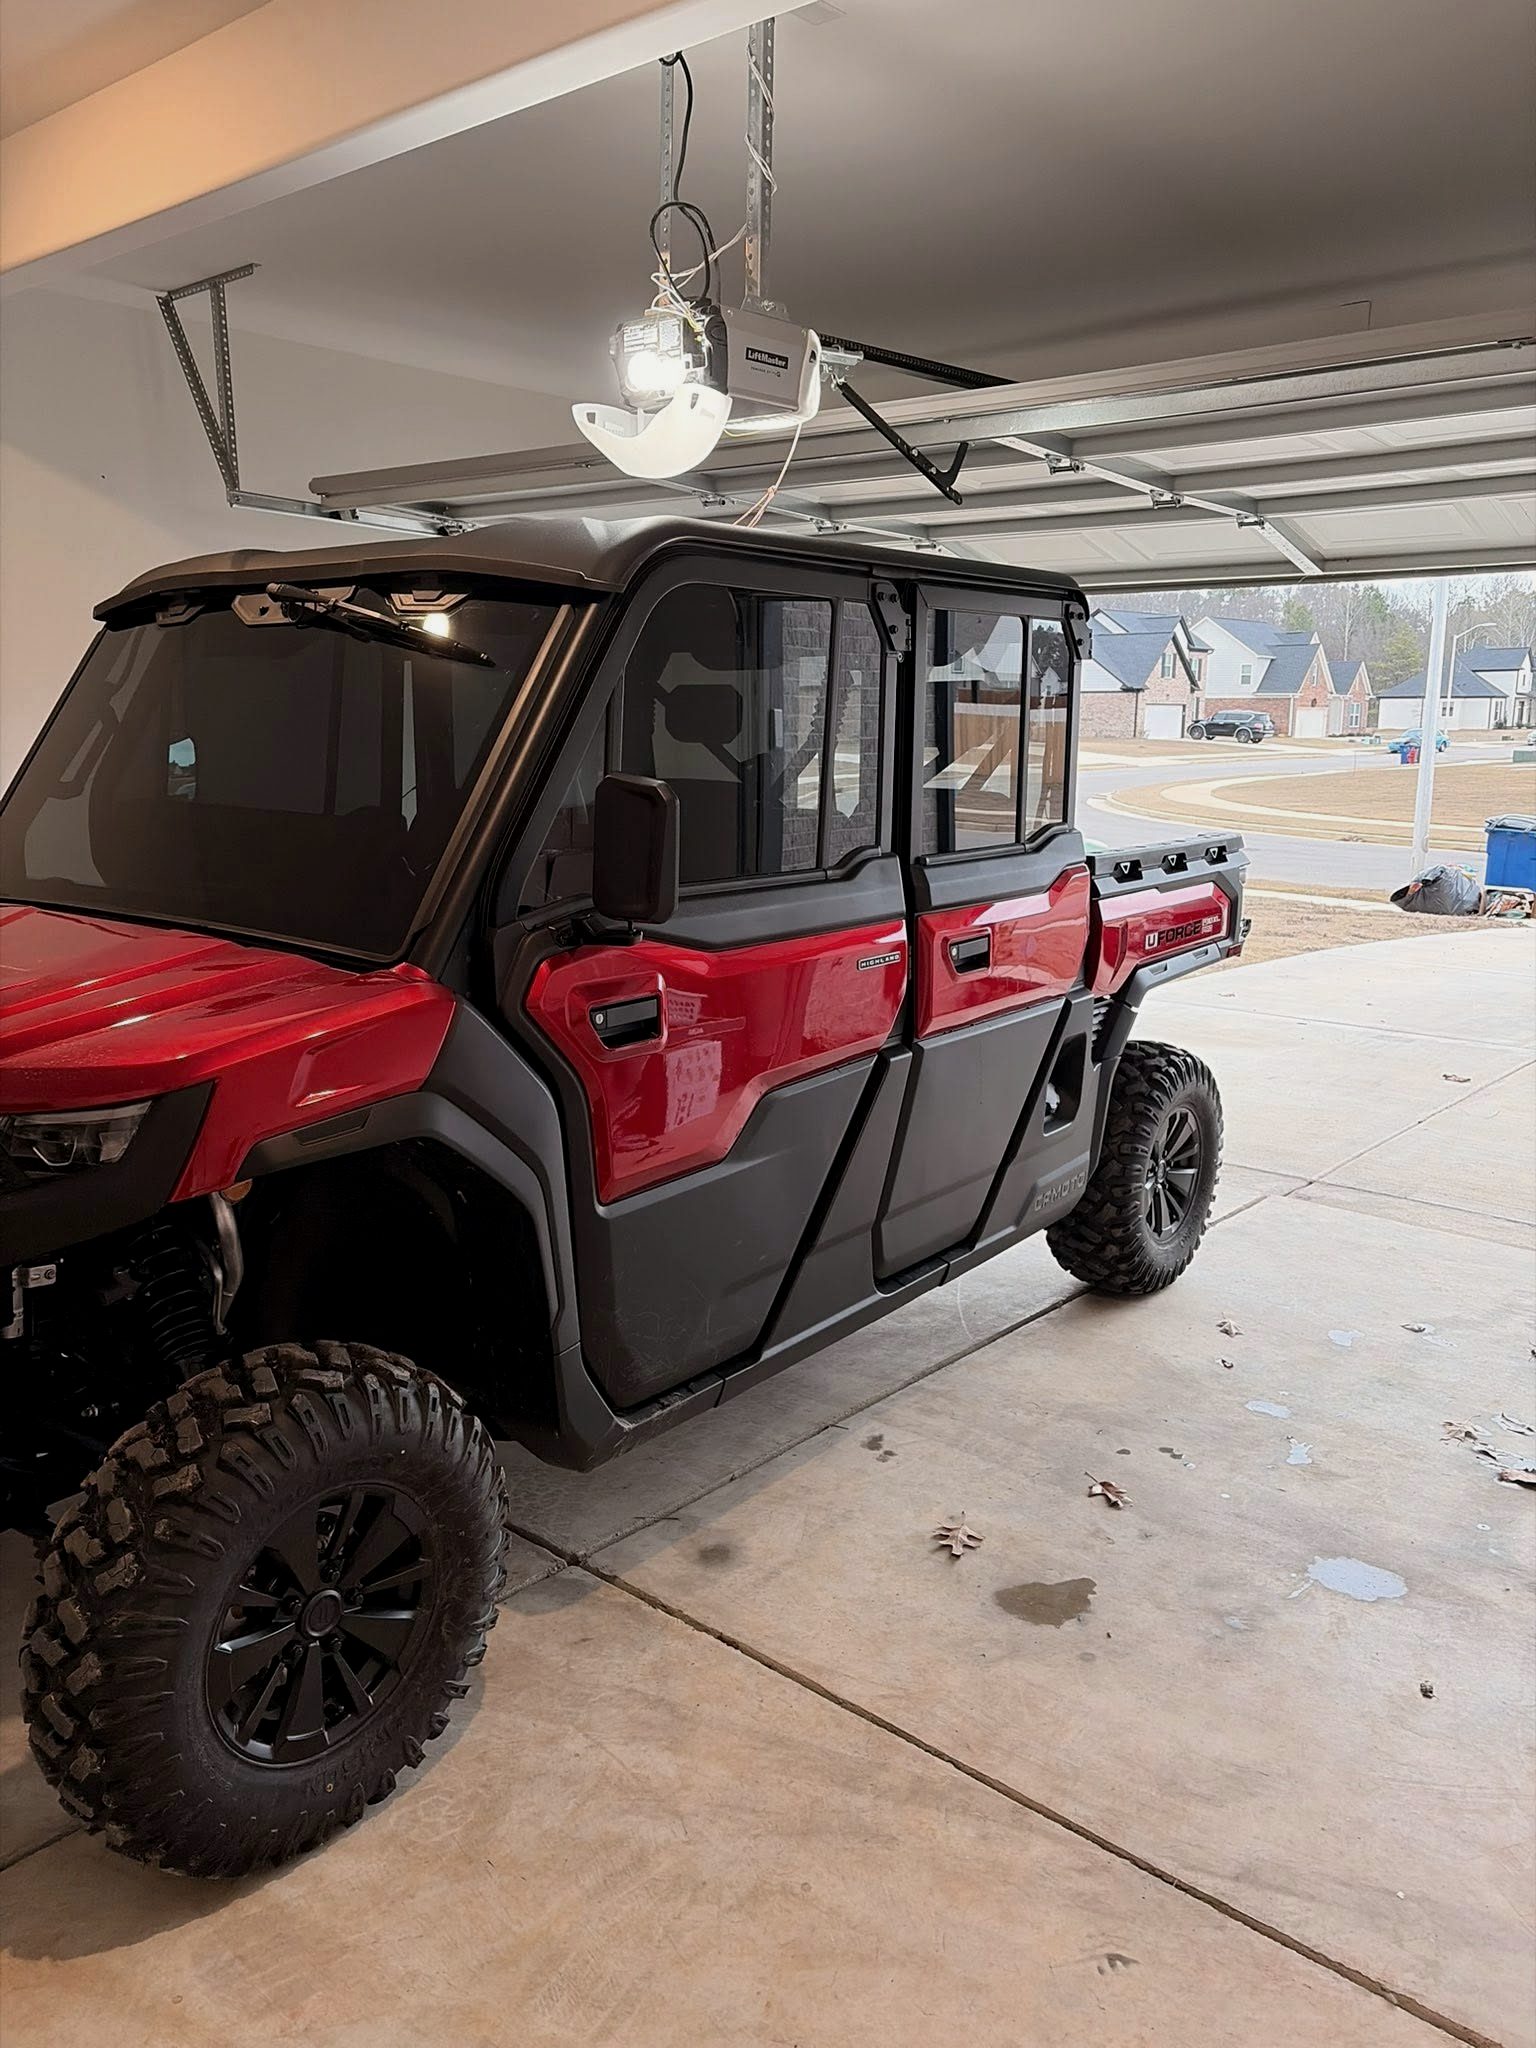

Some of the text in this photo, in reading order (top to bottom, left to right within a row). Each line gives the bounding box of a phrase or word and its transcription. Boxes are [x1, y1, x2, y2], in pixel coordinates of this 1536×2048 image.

[748, 349, 786, 367] LiftMaster
[1146, 920, 1202, 948] UFORCE
[861, 954, 900, 967] HIGHLAND
